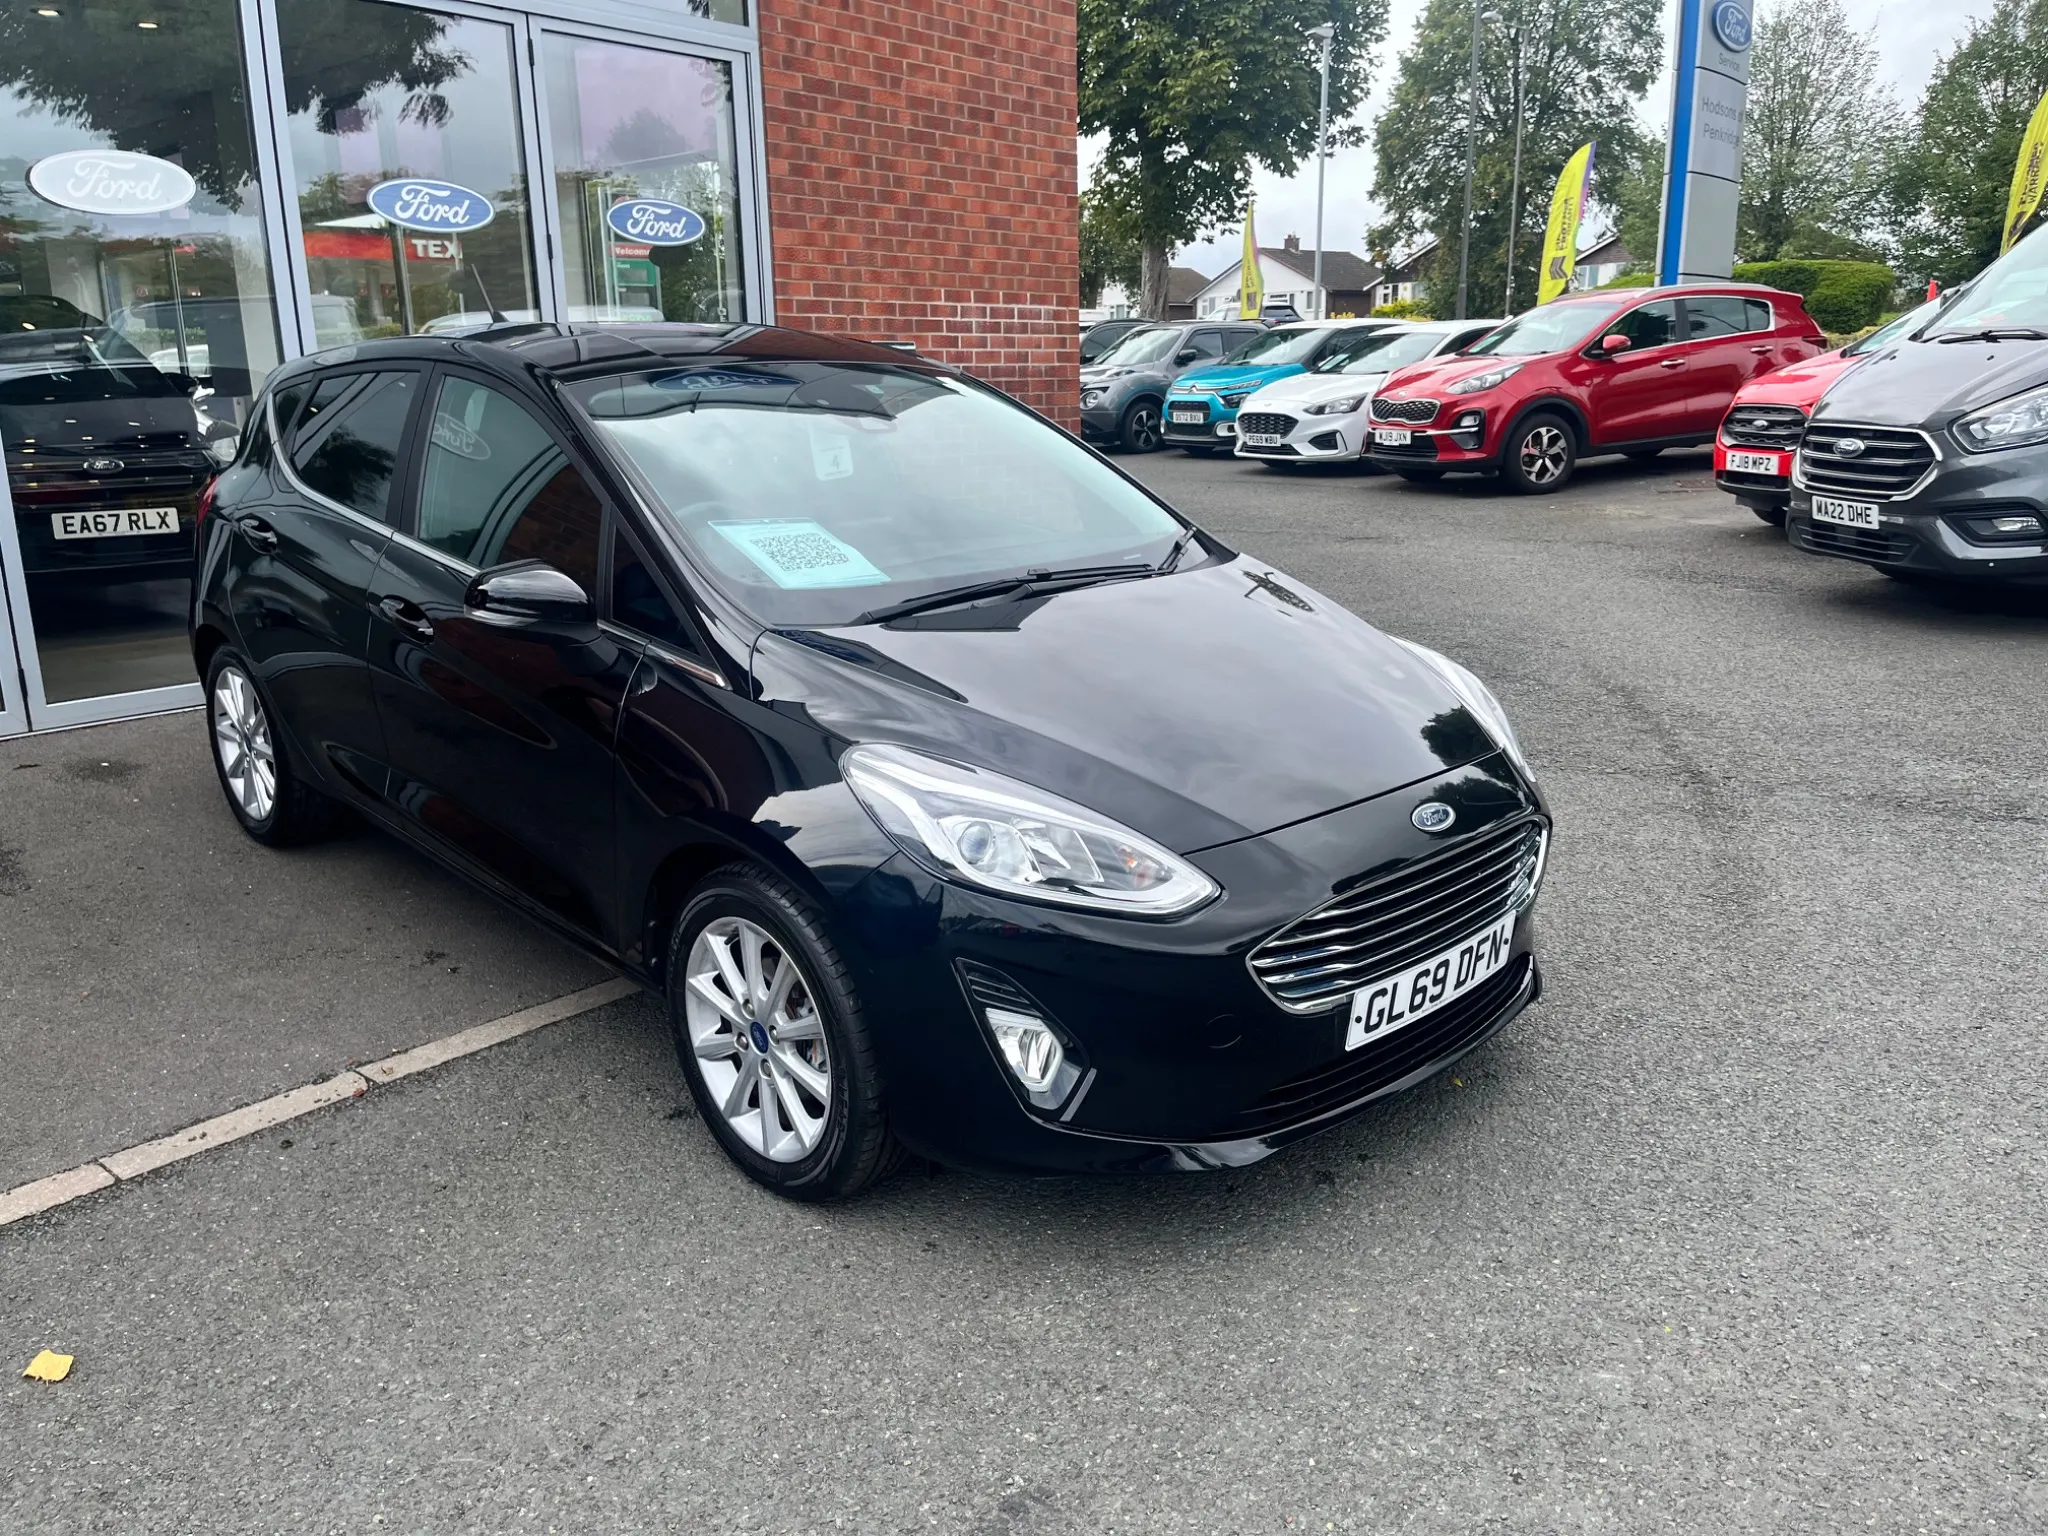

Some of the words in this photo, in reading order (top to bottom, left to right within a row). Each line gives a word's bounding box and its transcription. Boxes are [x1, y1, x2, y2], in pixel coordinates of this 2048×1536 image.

[1725, 7, 1748, 42] Ford
[1718, 52, 1741, 73] Service
[1702, 97, 1737, 121] Hodsons
[1703, 122, 1740, 150] Penkridge
[66, 158, 163, 201] Ford
[394, 185, 470, 225] Ford
[626, 204, 687, 239] Ford
[1248, 434, 1263, 445] PE69
[1394, 432, 1407, 443] JXN
[1730, 454, 1749, 472] FJ18
[1752, 456, 1771, 472] MPZ
[61, 513, 121, 535] EA67
[127, 511, 170, 531] RLX
[1848, 504, 1873, 525] DHE
[1422, 808, 1447, 826] Ford
[1363, 958, 1450, 1034] GL69
[1453, 923, 1506, 991] DFN
